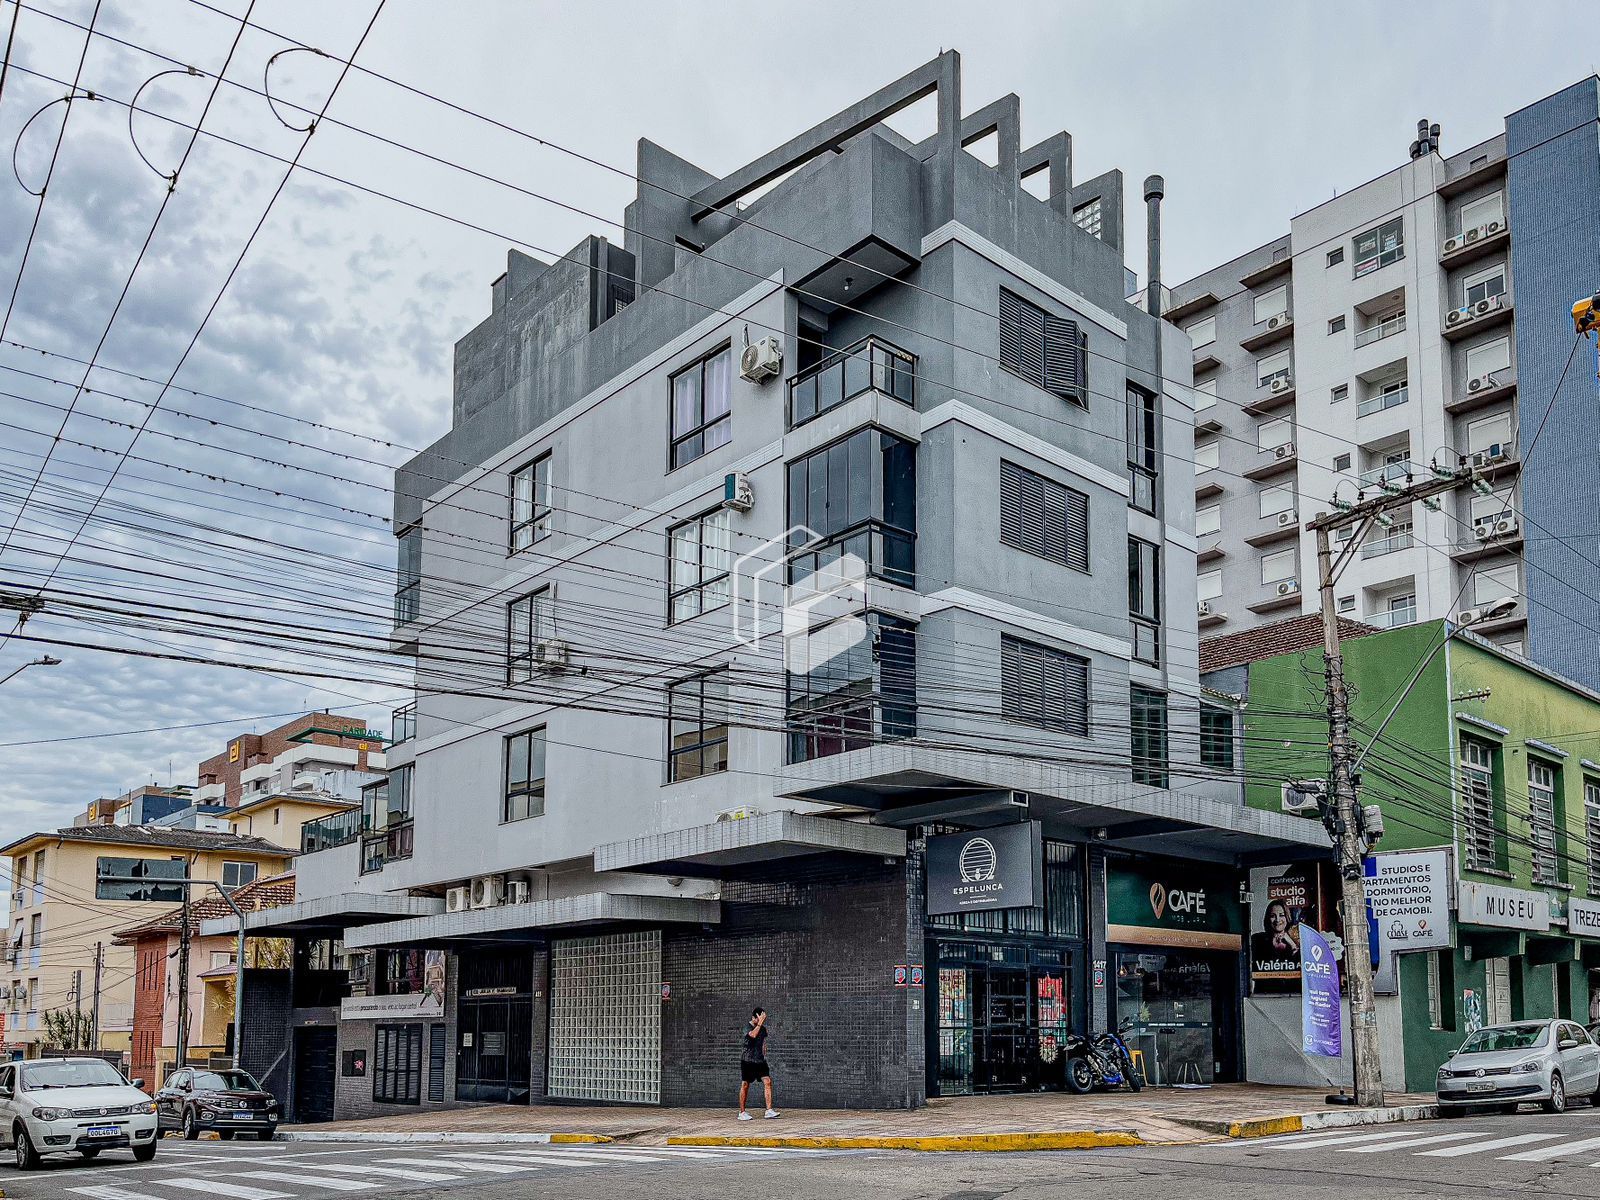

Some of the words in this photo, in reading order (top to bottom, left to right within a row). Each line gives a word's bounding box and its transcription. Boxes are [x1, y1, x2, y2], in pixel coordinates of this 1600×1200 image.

[1381, 865, 1425, 875] STUDIOS
[1425, 864, 1431, 872] E
[1270, 876, 1300, 885] conheça
[1362, 875, 1431, 886] PARTAMENTOS
[953, 883, 1003, 895] ESPELUNCA
[1270, 885, 1306, 897] studio
[1366, 885, 1431, 896] DORMITÓRIO,
[1168, 888, 1207, 914] CAFÉ
[1286, 896, 1306, 906] alfa
[1373, 898, 1389, 906] NO
[1390, 895, 1431, 905] MELHOR
[1389, 906, 1432, 916] CAMOBI.
[1486, 896, 1534, 919] MUSEU
[1574, 908, 1600, 928] TREZE
[1412, 929, 1433, 937] CAFÉ
[1255, 959, 1295, 971] Valéria
[1304, 961, 1331, 975] CAFÉ
